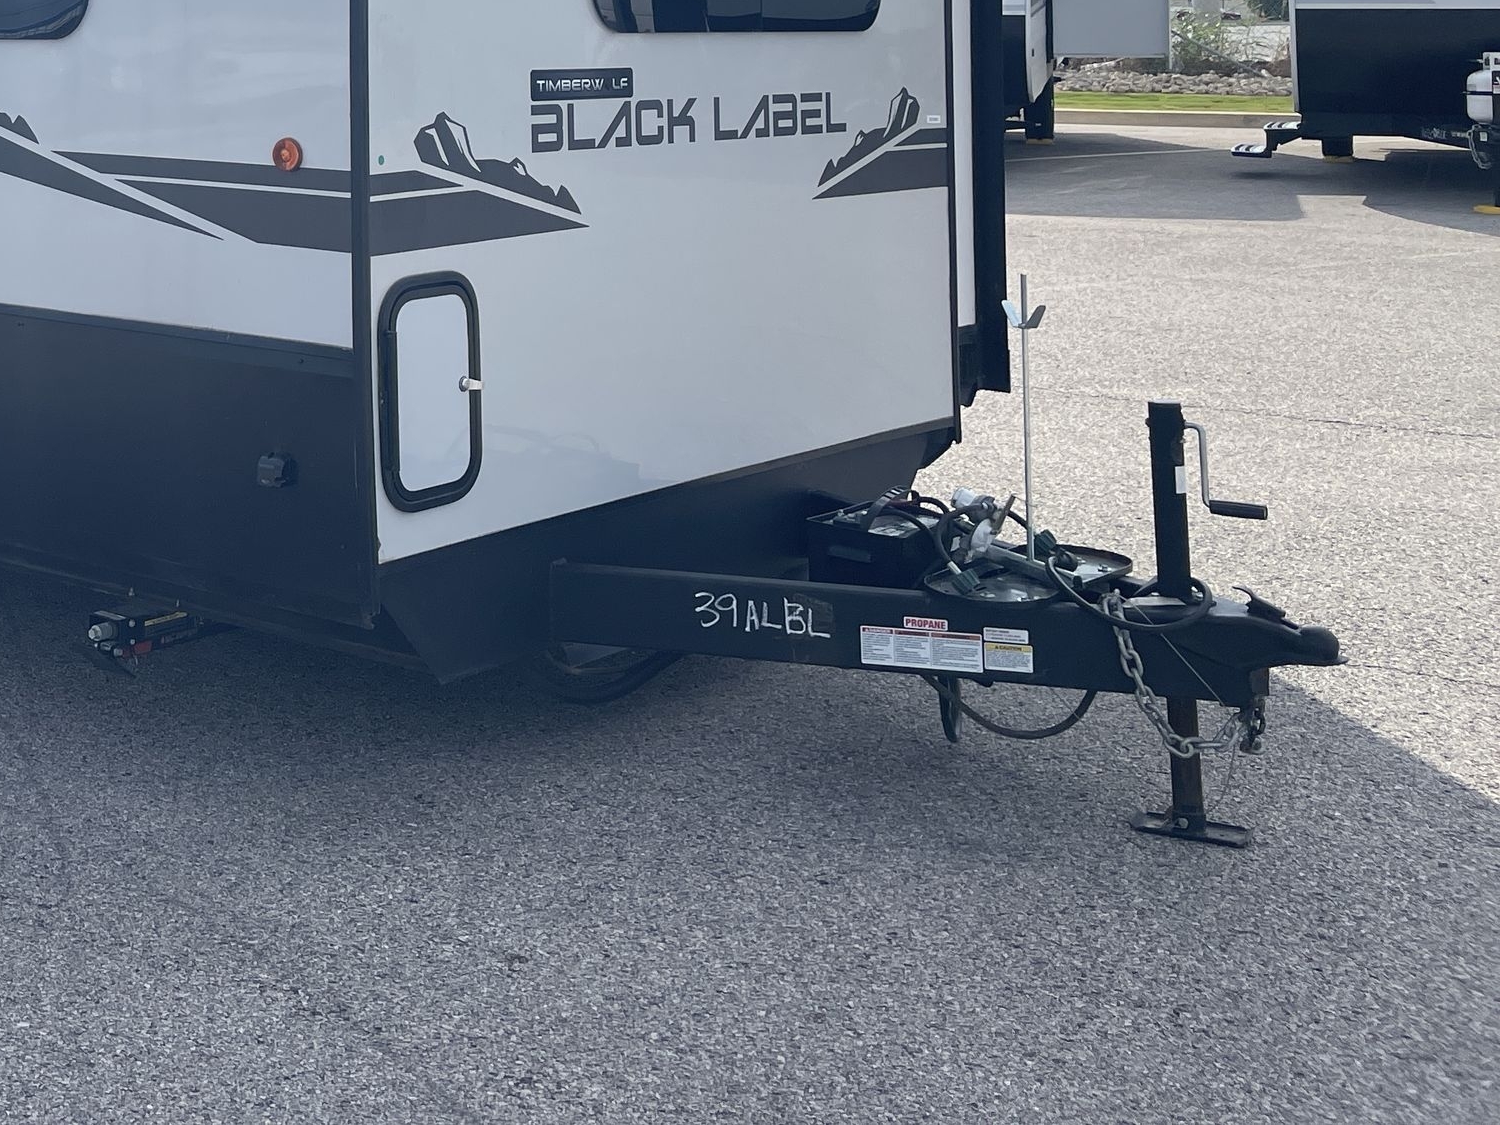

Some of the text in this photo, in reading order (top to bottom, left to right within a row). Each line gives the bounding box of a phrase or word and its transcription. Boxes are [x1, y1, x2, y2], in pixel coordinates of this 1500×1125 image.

[536, 77, 629, 92] TIMBERWLF
[530, 91, 847, 153] BLACK LABEL
[905, 618, 946, 630] PROPANE
